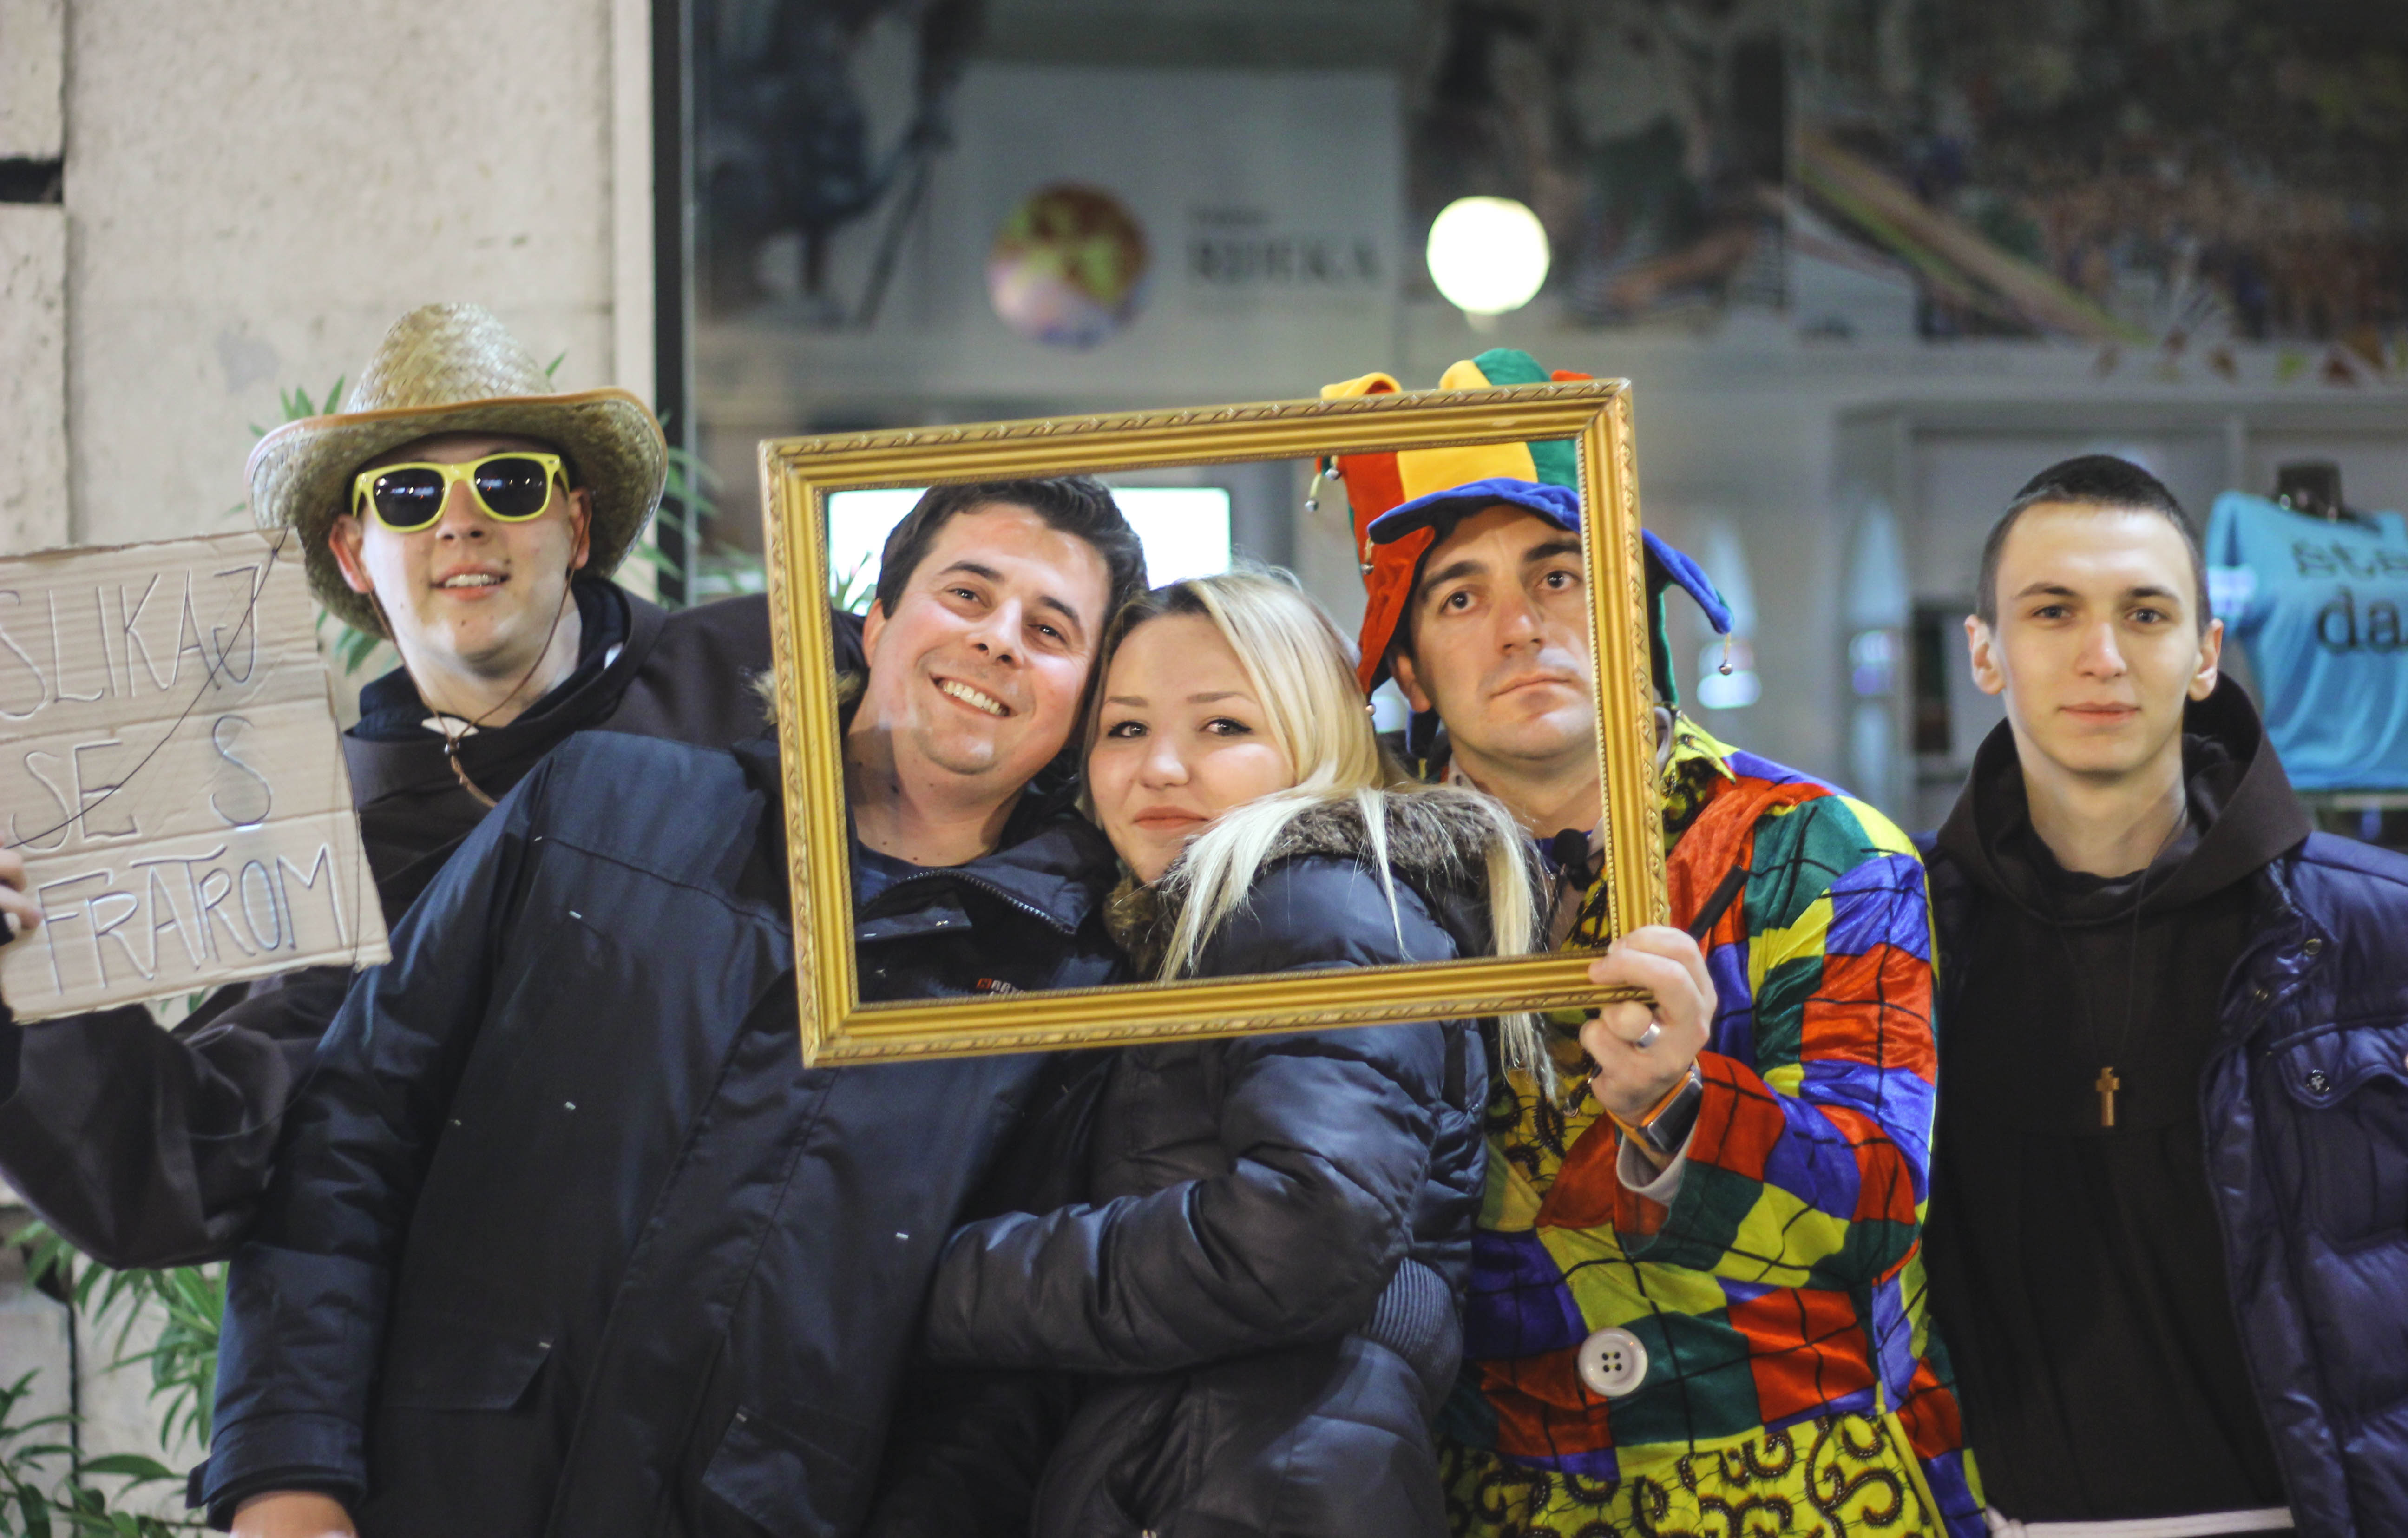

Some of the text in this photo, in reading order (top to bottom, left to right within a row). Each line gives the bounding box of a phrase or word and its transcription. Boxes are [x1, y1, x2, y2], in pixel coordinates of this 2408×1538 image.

[0, 564, 262, 719] SLIKAJ
[12, 714, 273, 854] SE S
[36, 842, 348, 996] FRATROM
